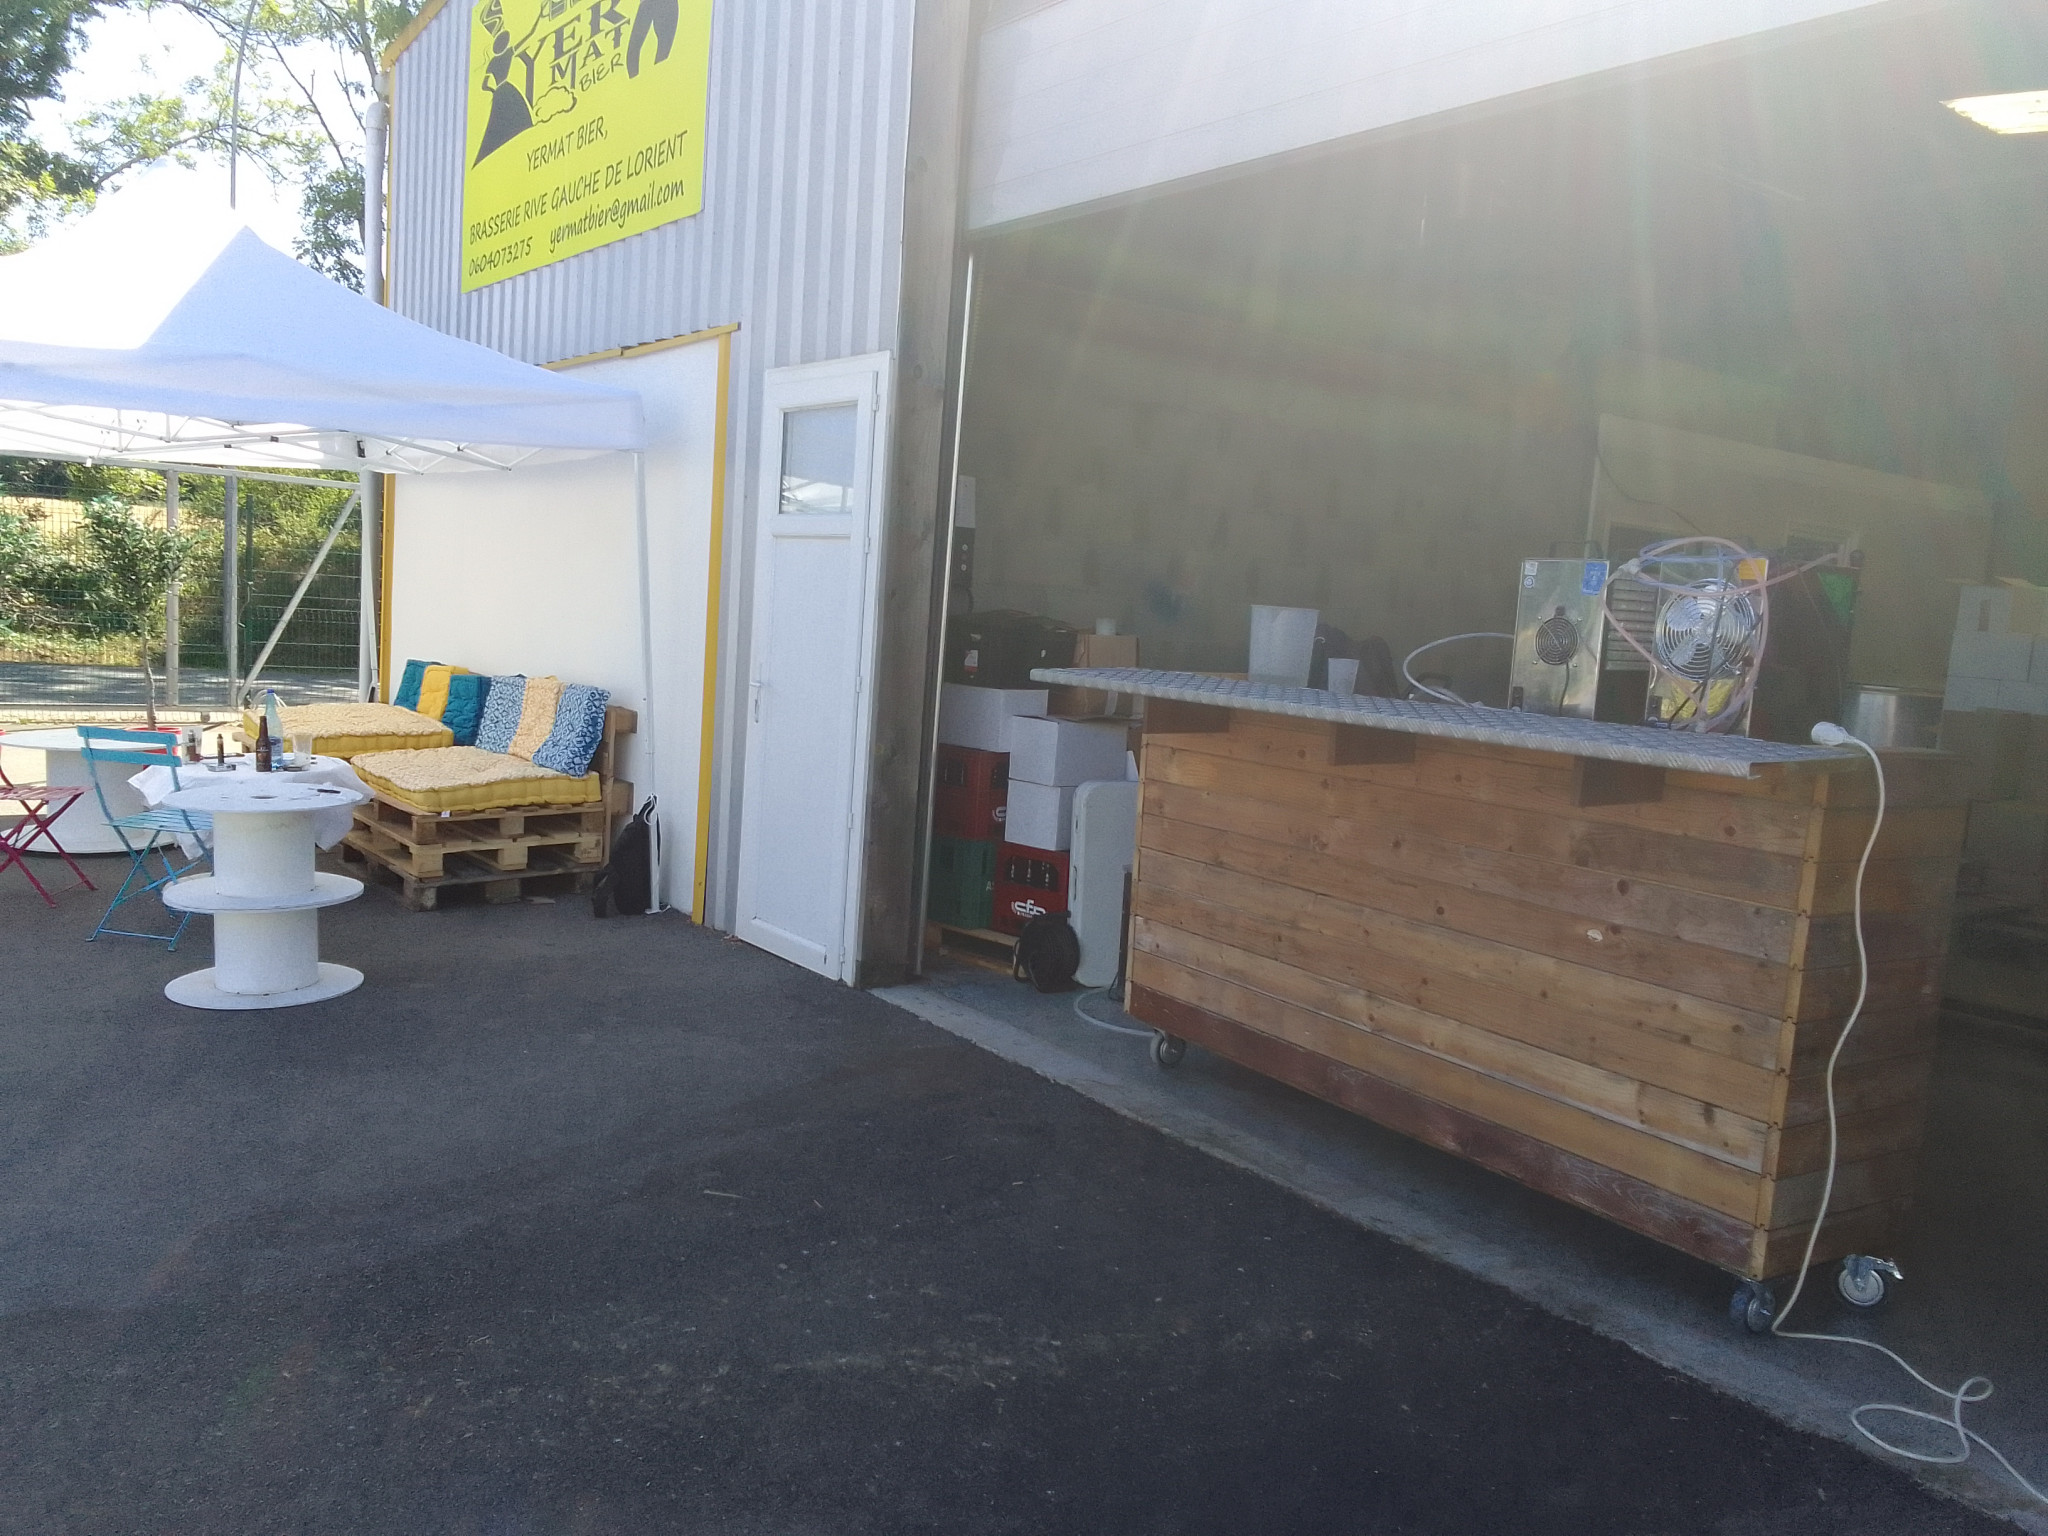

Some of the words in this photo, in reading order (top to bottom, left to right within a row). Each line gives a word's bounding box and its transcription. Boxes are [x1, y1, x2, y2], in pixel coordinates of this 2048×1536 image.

[514, 0, 629, 109] YER
[549, 18, 630, 89] MAT
[580, 52, 624, 92] BIER
[526, 131, 574, 172] YERMAT
[577, 116, 608, 150] BIER,
[468, 236, 533, 277] 0604073275
[549, 179, 684, 254] yermatbier@gmail.com
[470, 205, 521, 245] BRASSERIE
[523, 192, 548, 222] RIVE
[551, 169, 600, 212] GAUCHE
[605, 160, 623, 190] DE
[627, 130, 688, 180] LORIENT
